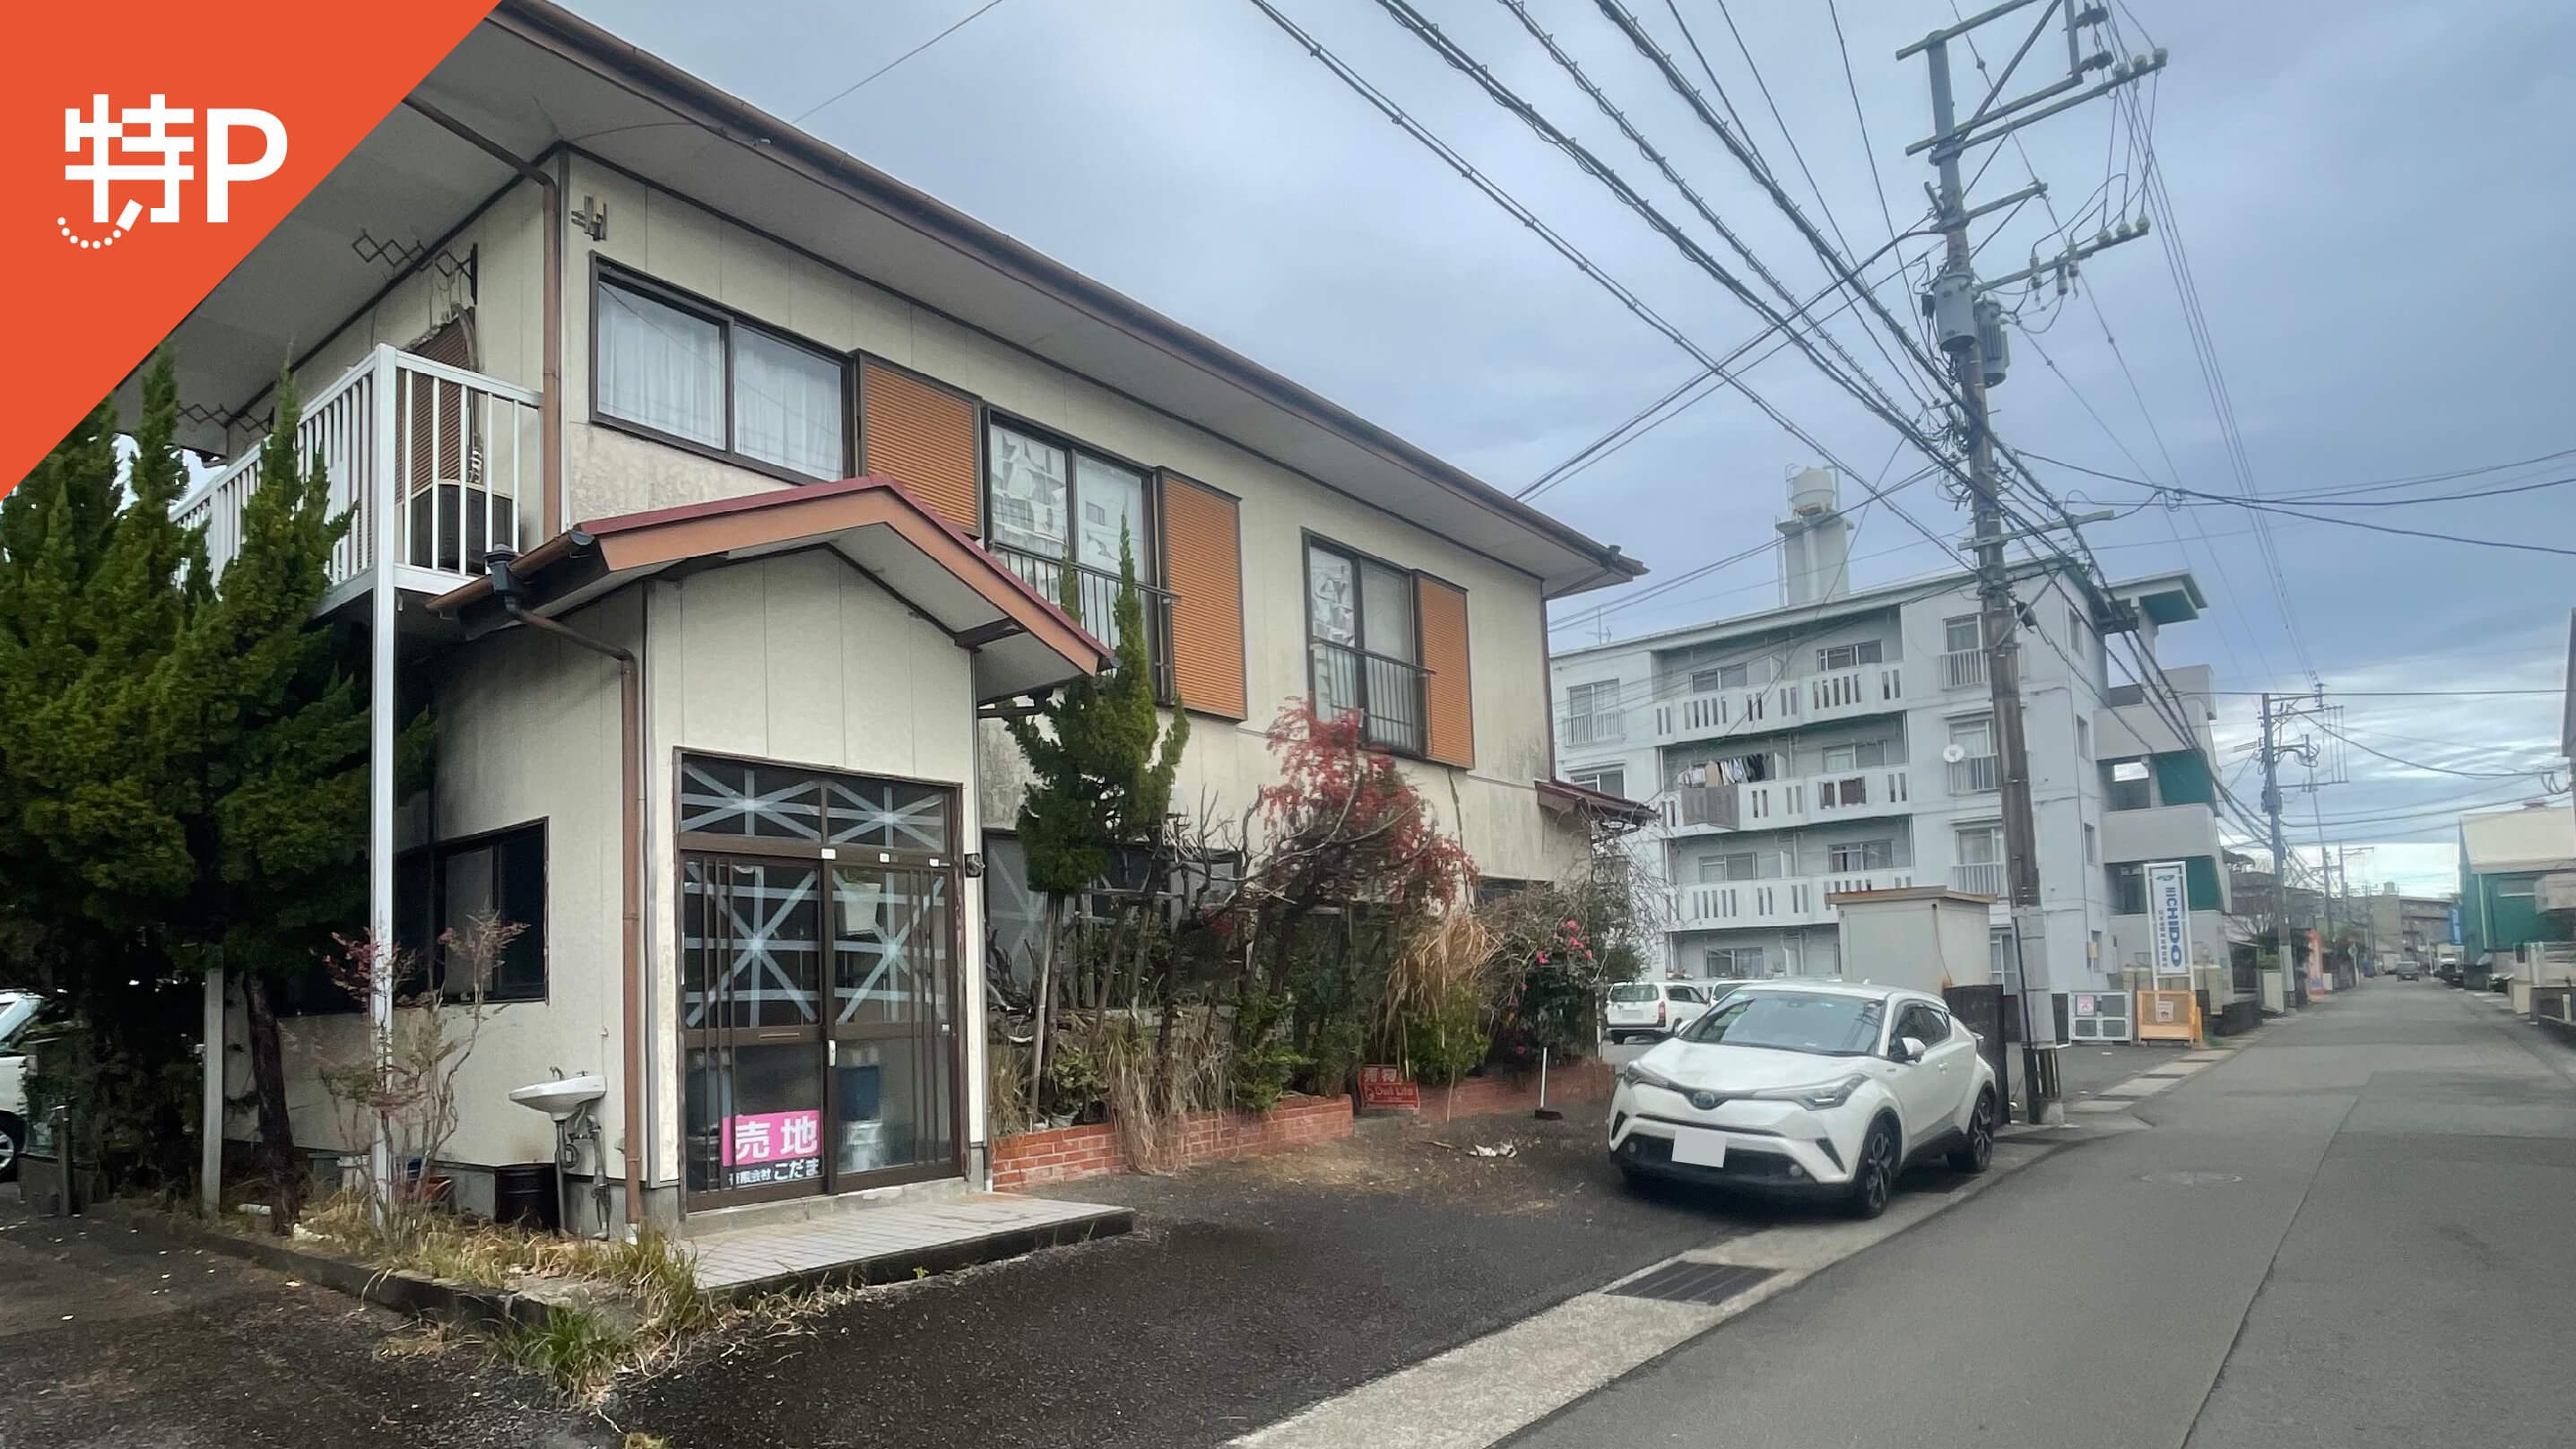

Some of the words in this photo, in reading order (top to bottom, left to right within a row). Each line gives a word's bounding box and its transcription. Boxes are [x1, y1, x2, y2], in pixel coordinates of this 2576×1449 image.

[735, 1115, 818, 1160] 売地
[774, 1158, 820, 1181] こだま
